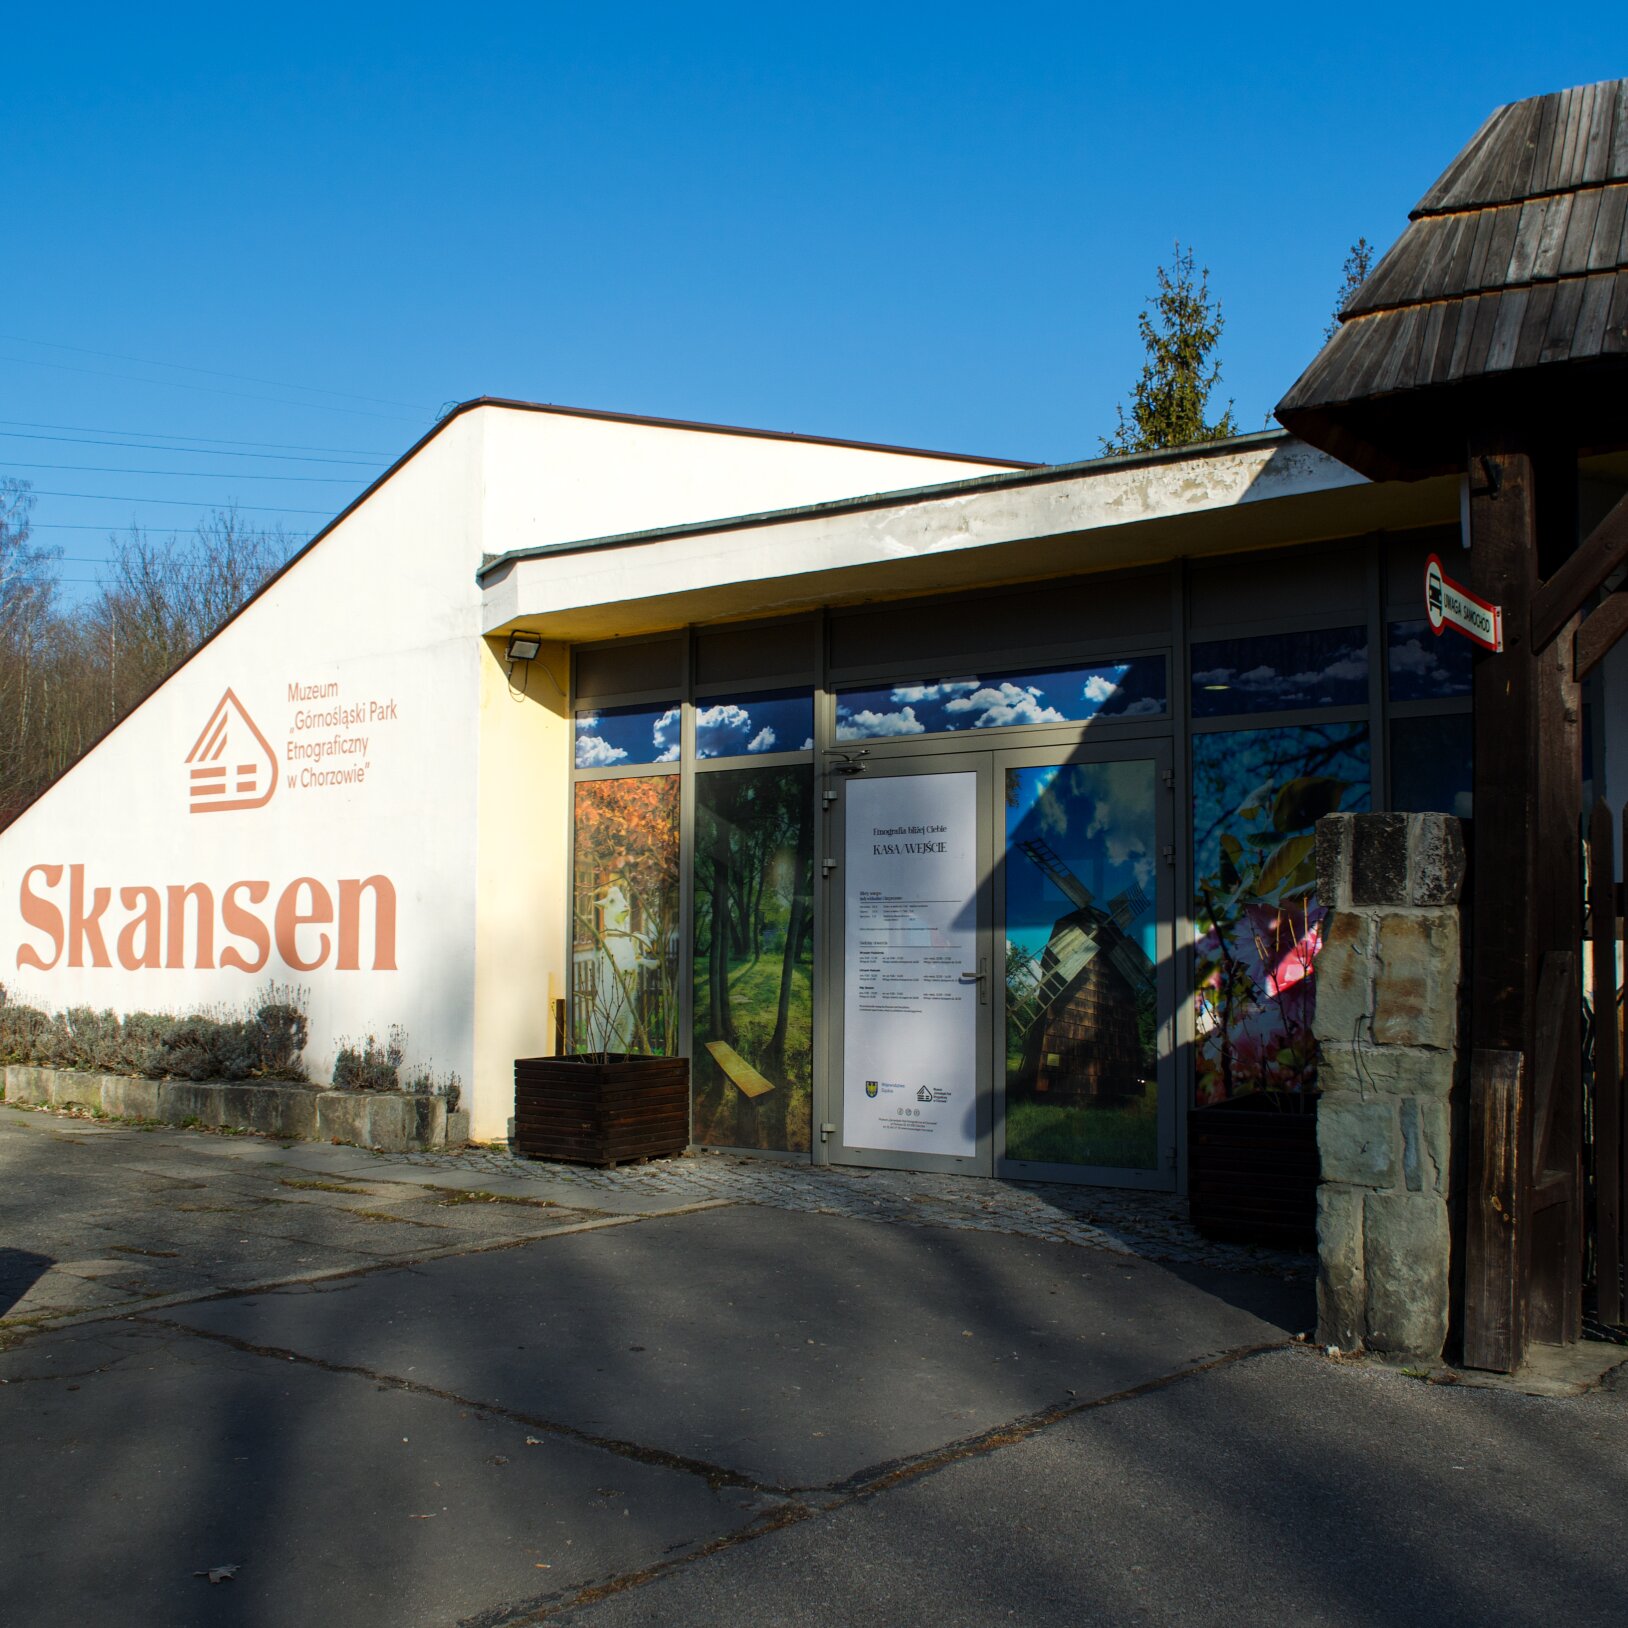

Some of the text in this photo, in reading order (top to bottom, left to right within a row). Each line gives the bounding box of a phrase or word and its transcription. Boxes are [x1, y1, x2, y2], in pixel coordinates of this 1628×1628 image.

[1443, 593, 1462, 616] UWAGA
[288, 682, 338, 702] Muzeum
[289, 698, 398, 733] „Górnośląski Park
[287, 735, 369, 763] Etnograficzny
[287, 776, 297, 789] w
[926, 824, 948, 834] Ciebie
[16, 863, 398, 973] Skansen
